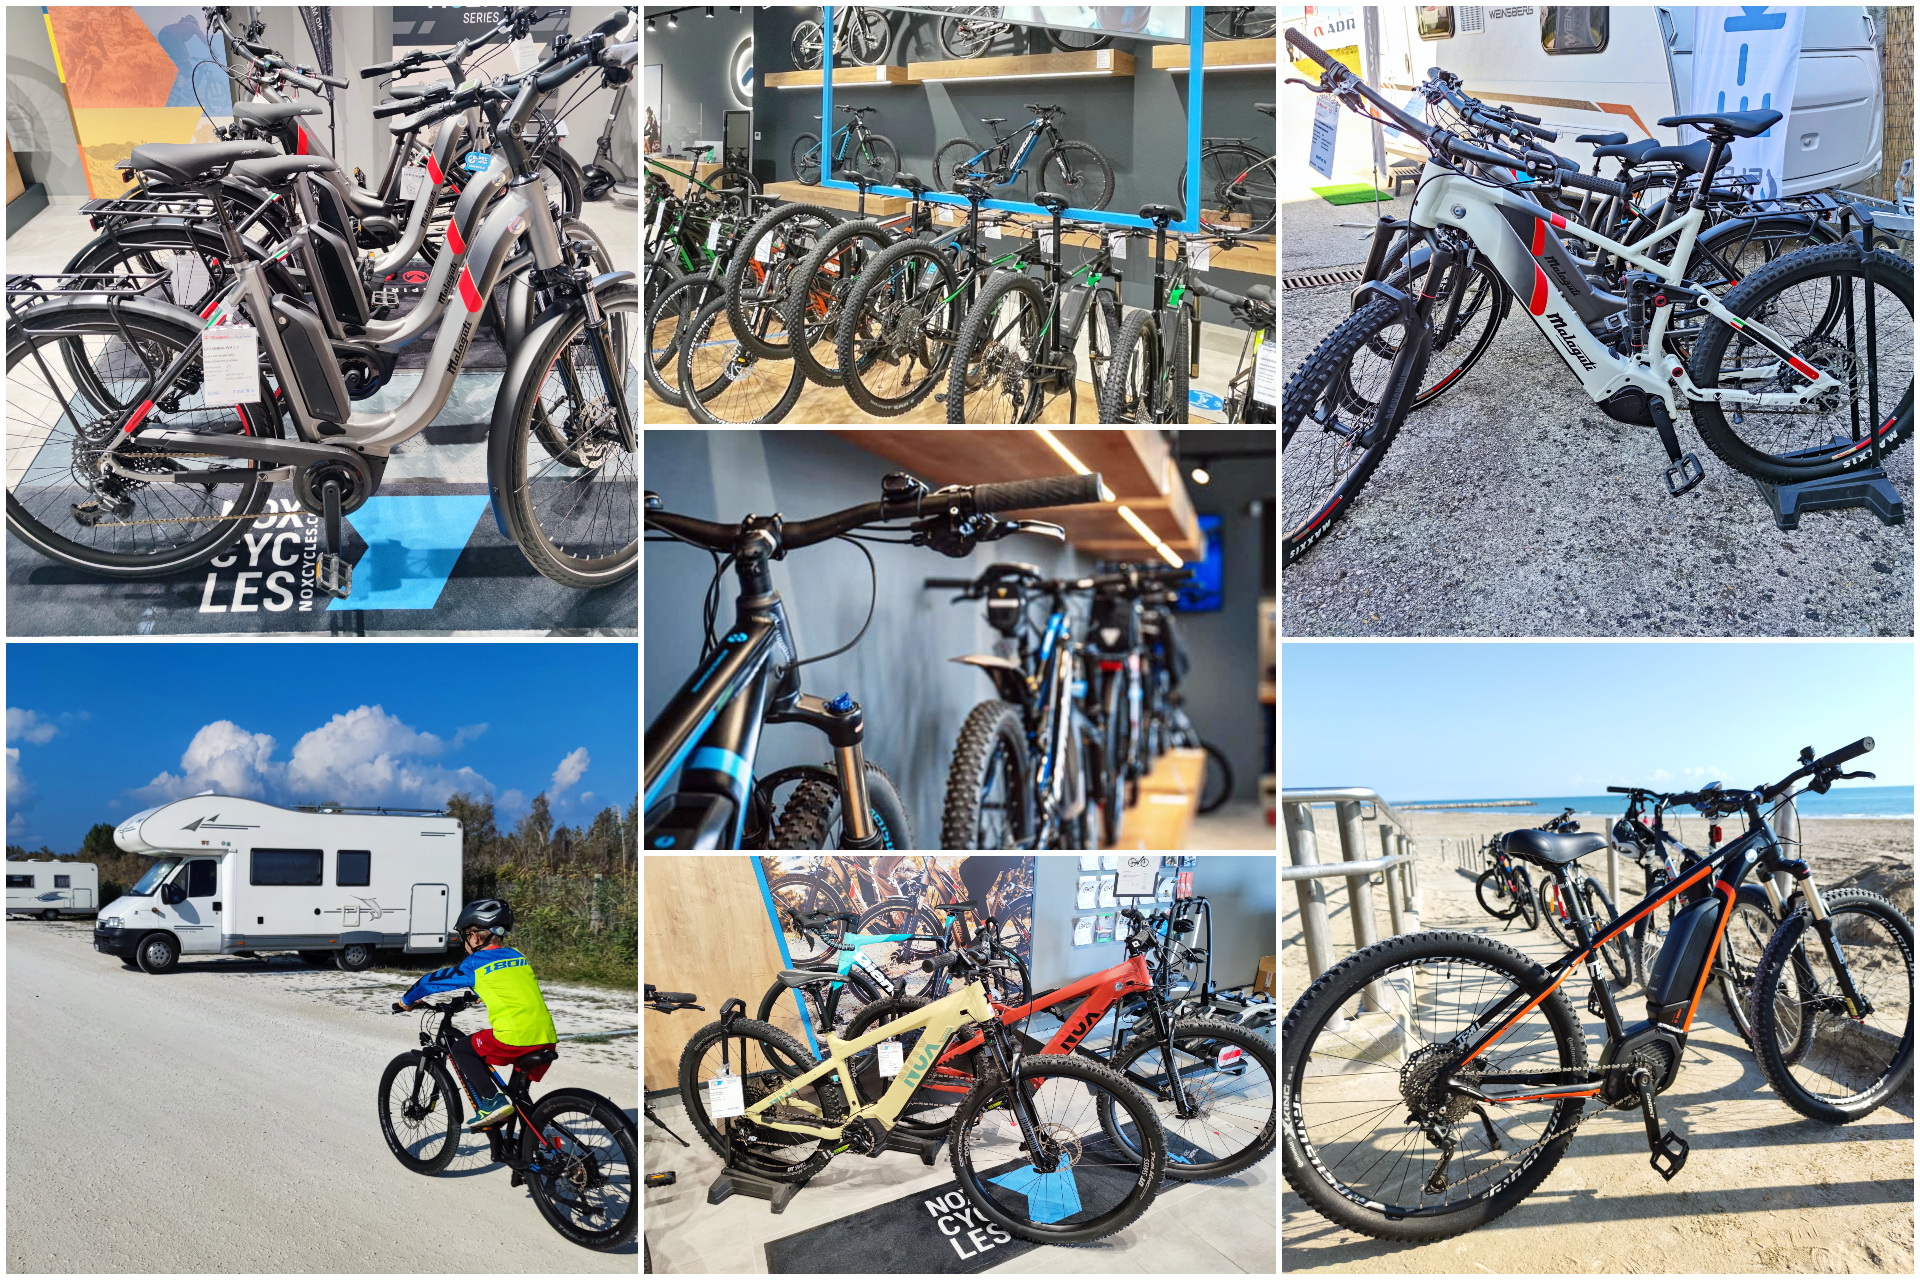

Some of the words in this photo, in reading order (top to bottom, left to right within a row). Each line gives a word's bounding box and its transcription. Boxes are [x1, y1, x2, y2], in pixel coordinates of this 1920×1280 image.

[463, 12, 500, 24] SERIES
[1489, 6, 1534, 20] WEINSBERG
[421, 190, 437, 228] Malaguti
[438, 261, 459, 305] Malaguti
[1544, 255, 1582, 297] Malaguti
[447, 320, 473, 375] Malaguti
[1546, 312, 1597, 372] Malaguti
[1290, 518, 1331, 559] MAXXIS
[199, 571, 295, 613] LES
[853, 951, 896, 997] Bian
[1060, 1012, 1101, 1051] NUA
[902, 1042, 941, 1088] NUA
[1645, 1092, 1656, 1120] GHOST
[924, 1187, 973, 1217] NO
[949, 1222, 1012, 1260] LES
